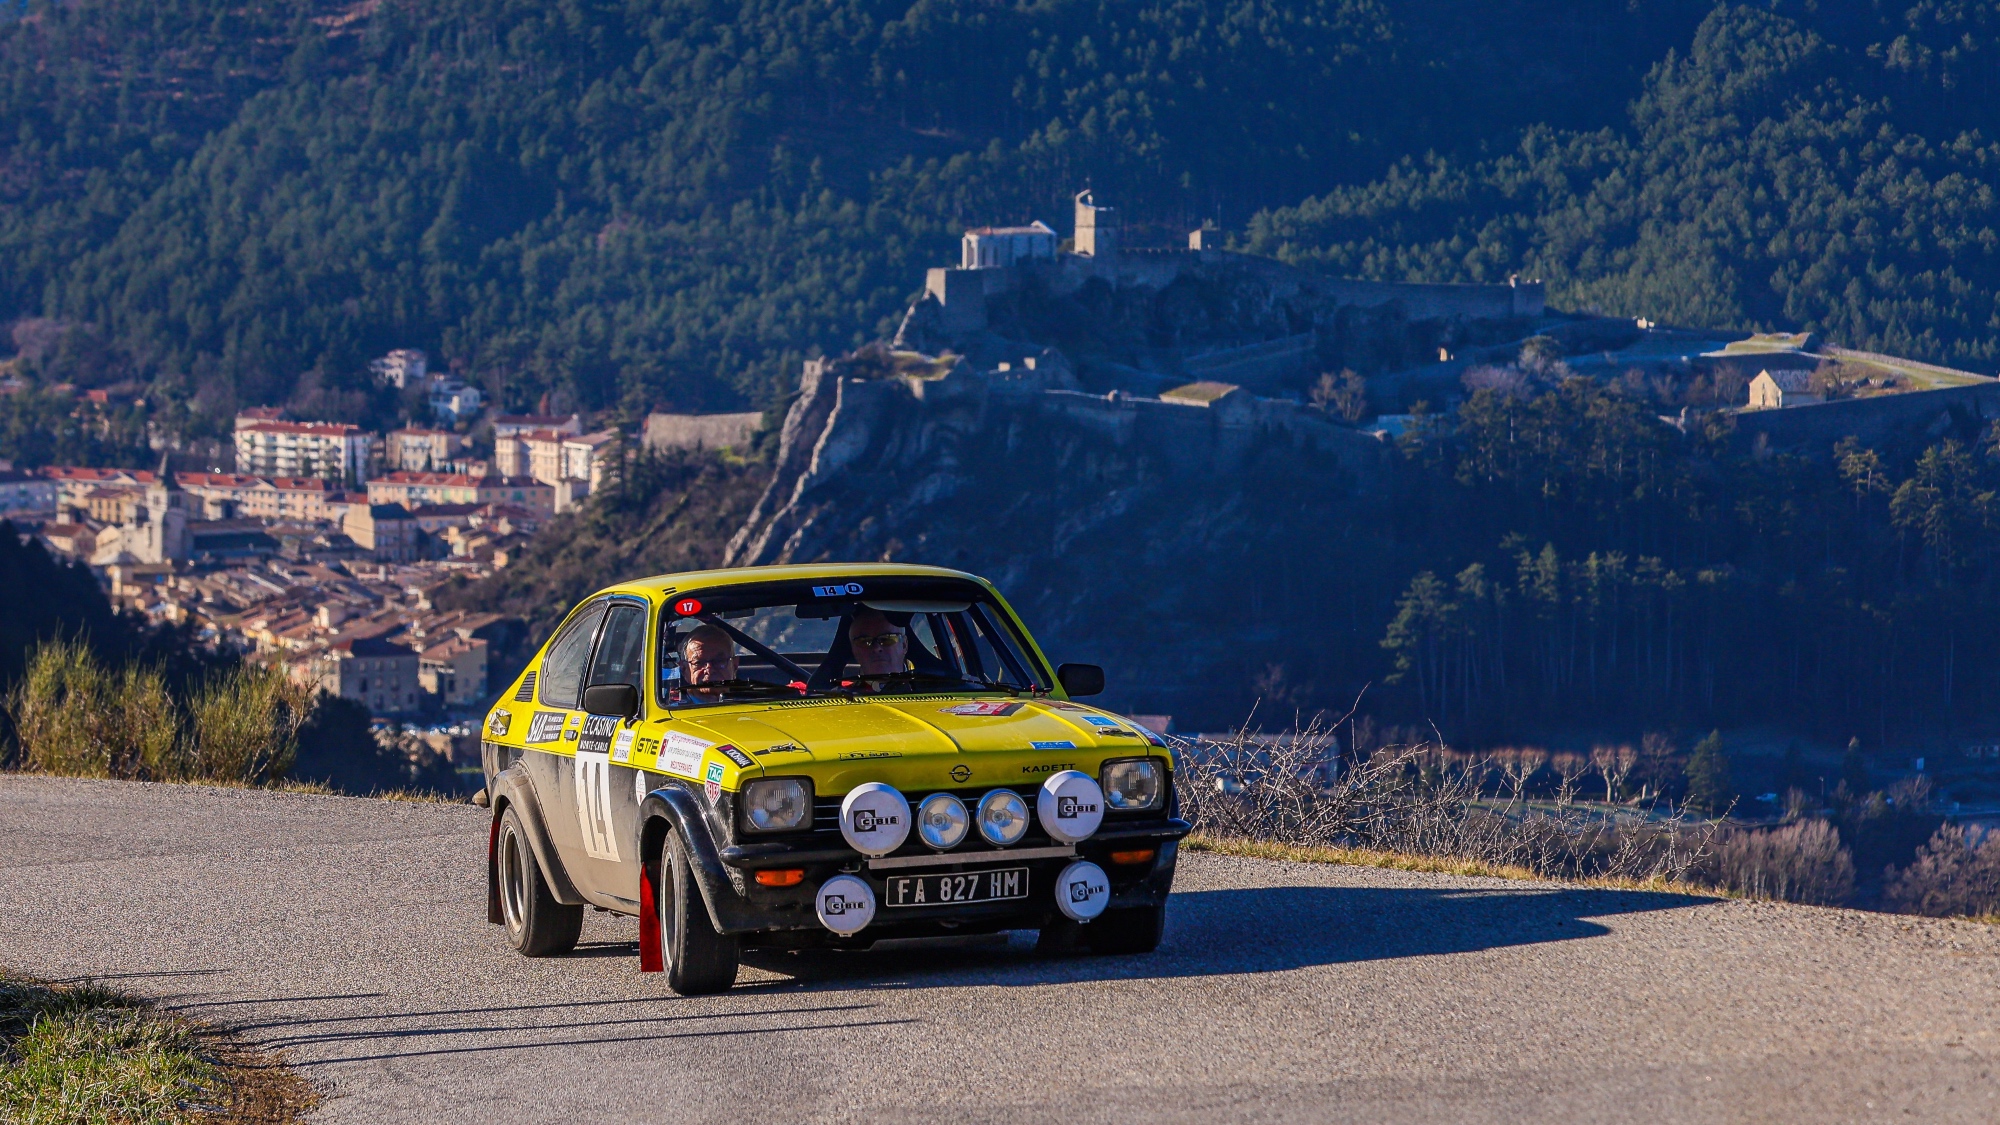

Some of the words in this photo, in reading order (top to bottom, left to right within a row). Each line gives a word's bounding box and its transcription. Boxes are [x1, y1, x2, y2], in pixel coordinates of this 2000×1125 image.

[822, 586, 837, 596] 14
[682, 602, 693, 612] 17
[589, 716, 618, 737] CASINO
[579, 740, 608, 752] MONTE-CARLO
[709, 766, 722, 782] TAG
[1022, 763, 1076, 773] KADETT
[581, 761, 610, 853] 14
[898, 878, 926, 904] FA
[940, 875, 979, 902] 827
[990, 871, 1019, 897] HM
